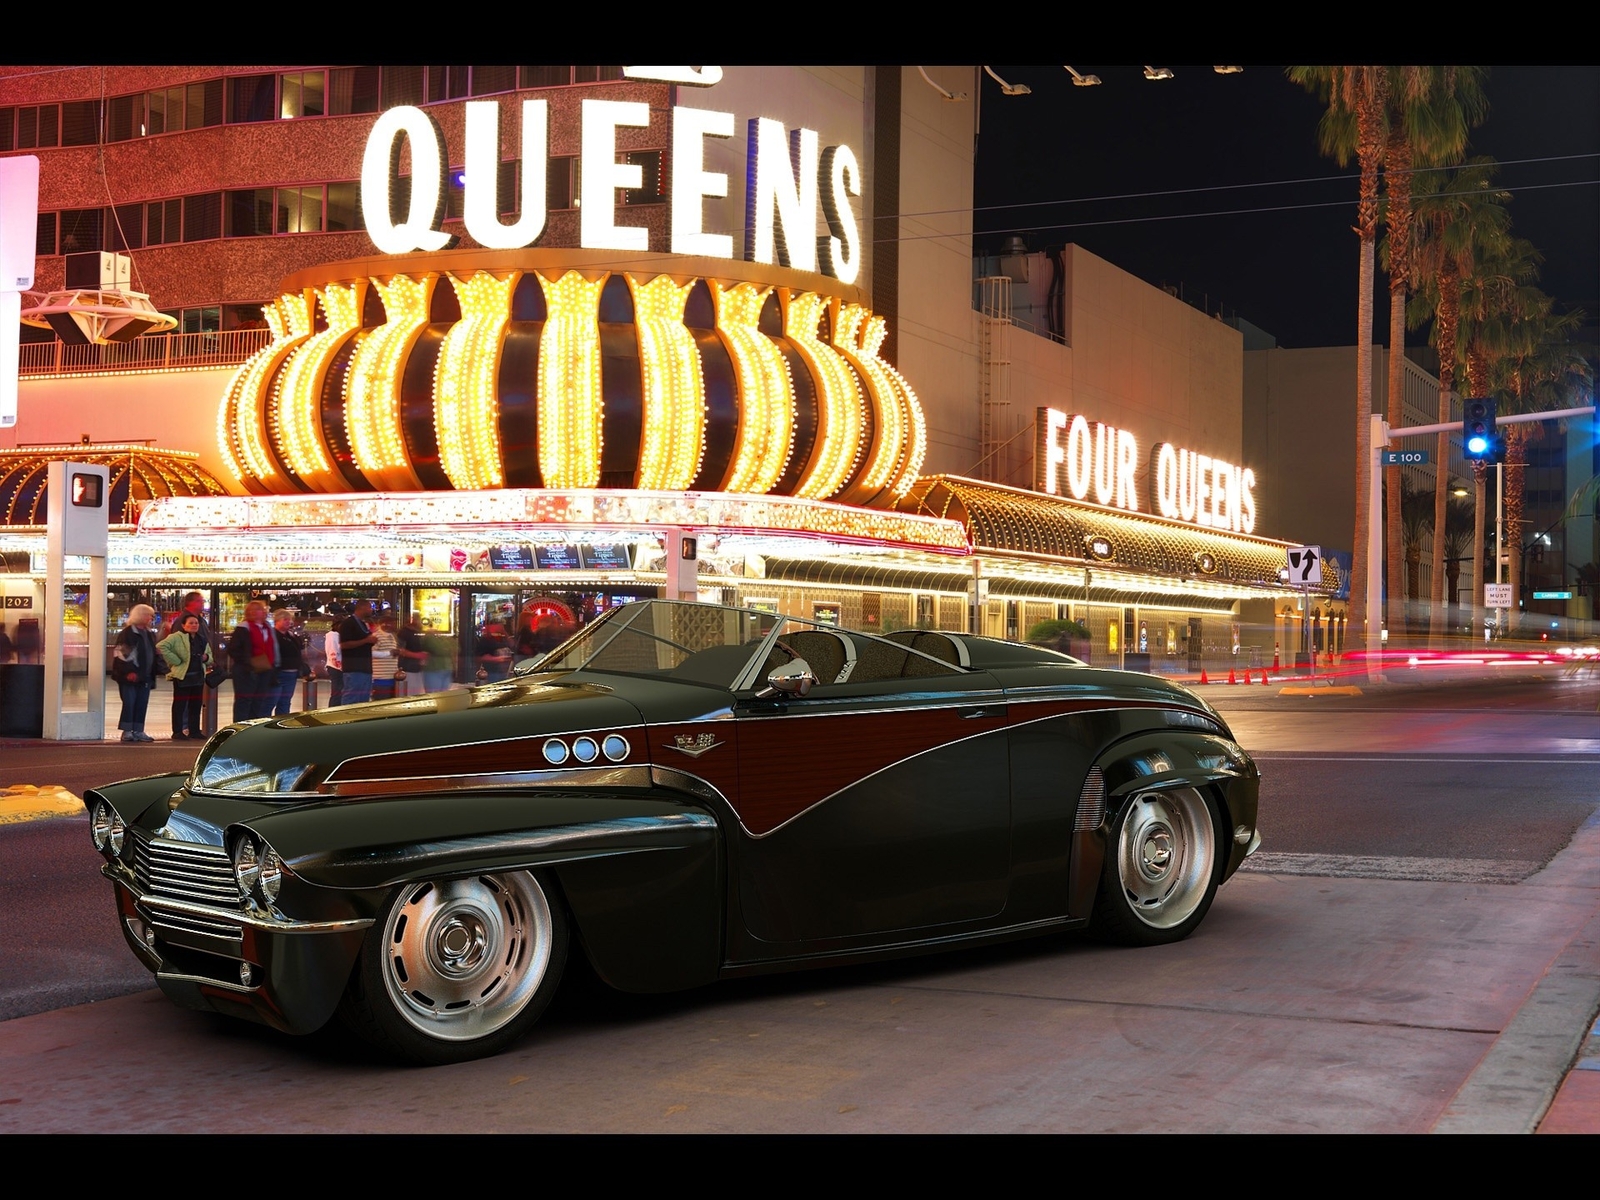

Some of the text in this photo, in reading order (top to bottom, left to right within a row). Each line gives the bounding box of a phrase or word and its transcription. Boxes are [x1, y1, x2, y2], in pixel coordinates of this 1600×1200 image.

[361, 99, 863, 286] QUEENS
[1389, 453, 1422, 463] E 100
[1046, 407, 1257, 535] FOUR QUEENS
[133, 554, 180, 565] Receive
[7, 598, 29, 607] 202
